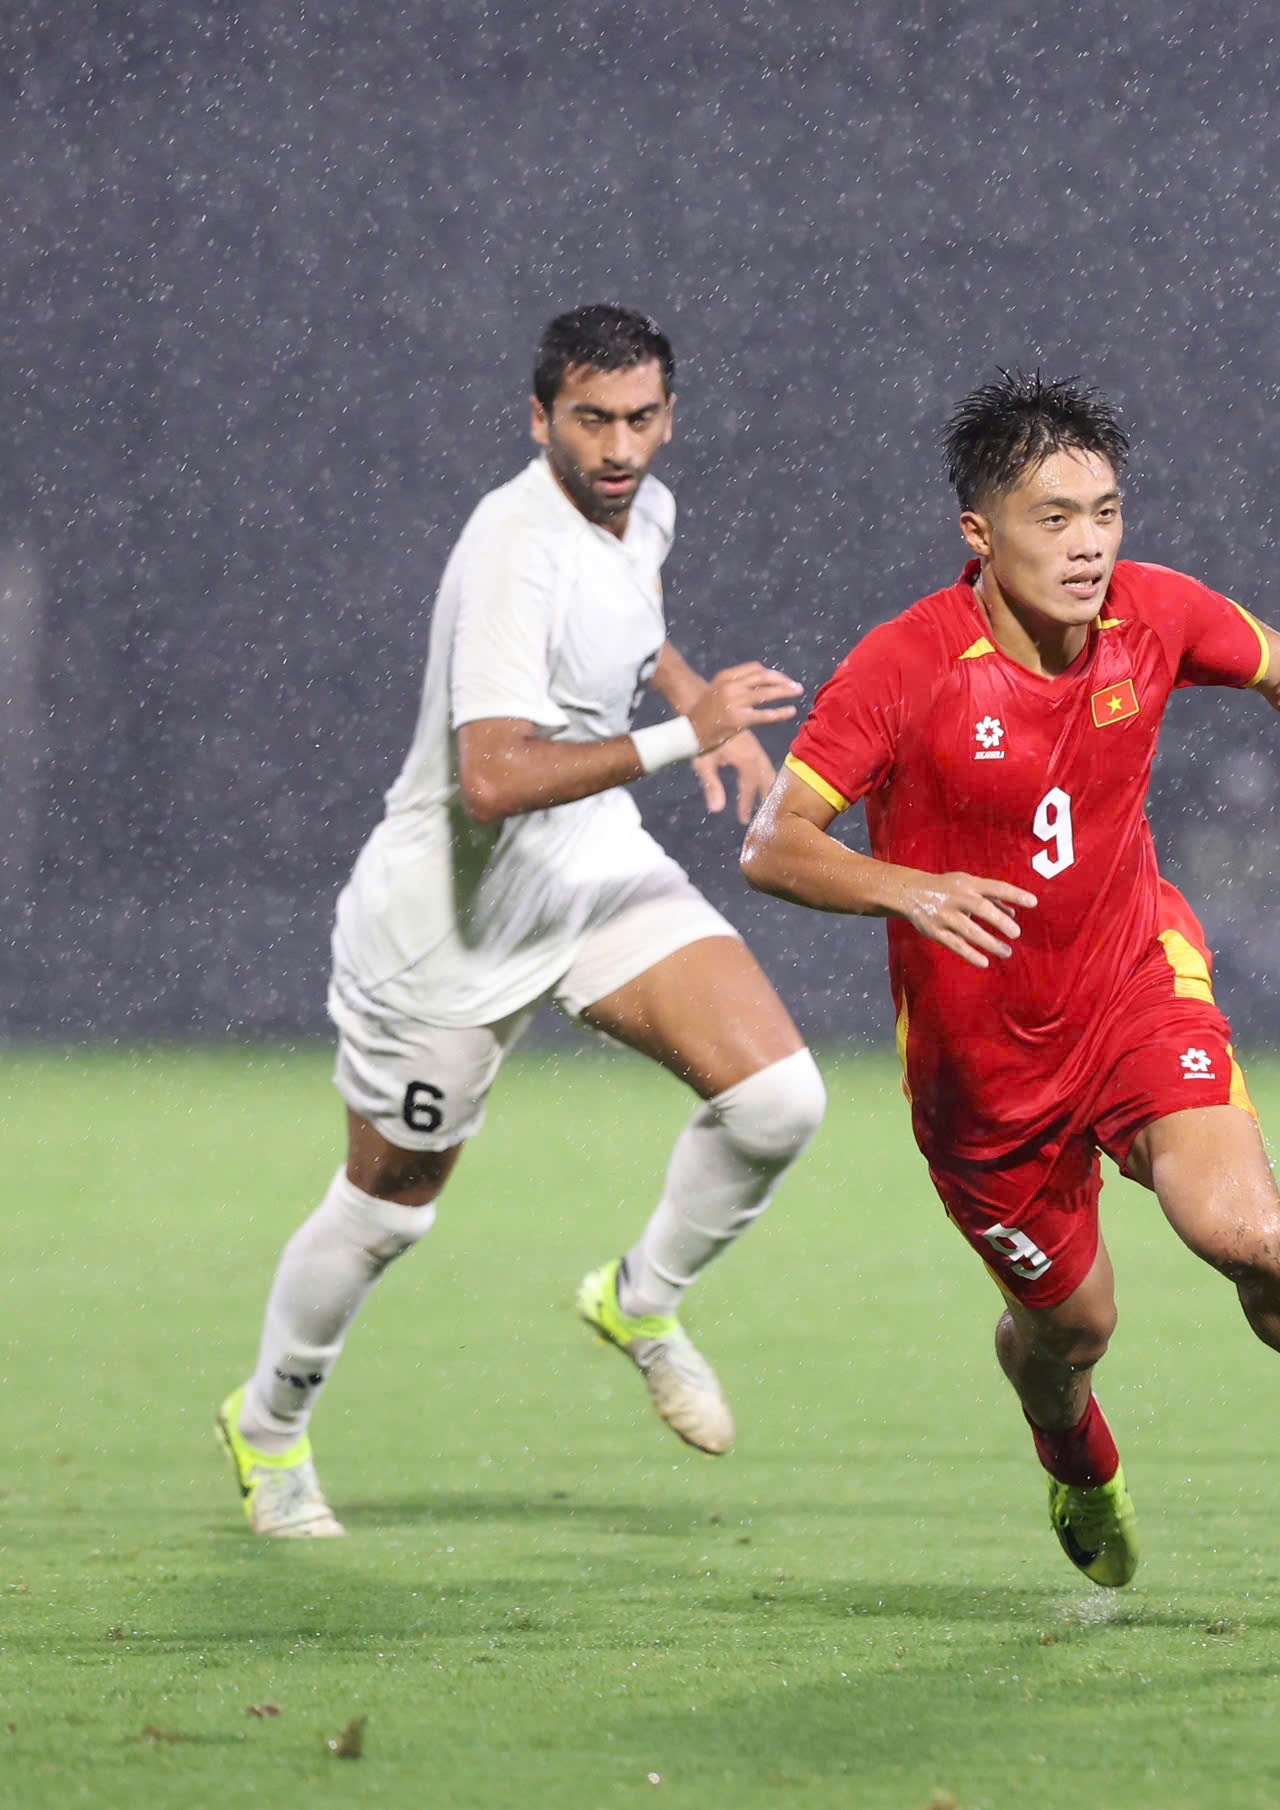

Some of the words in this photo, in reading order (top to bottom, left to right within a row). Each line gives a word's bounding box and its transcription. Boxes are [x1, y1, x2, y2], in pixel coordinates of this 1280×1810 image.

[1031, 786, 1075, 880] 9
[402, 1081, 446, 1133] 6
[981, 1223, 1053, 1280] 9
